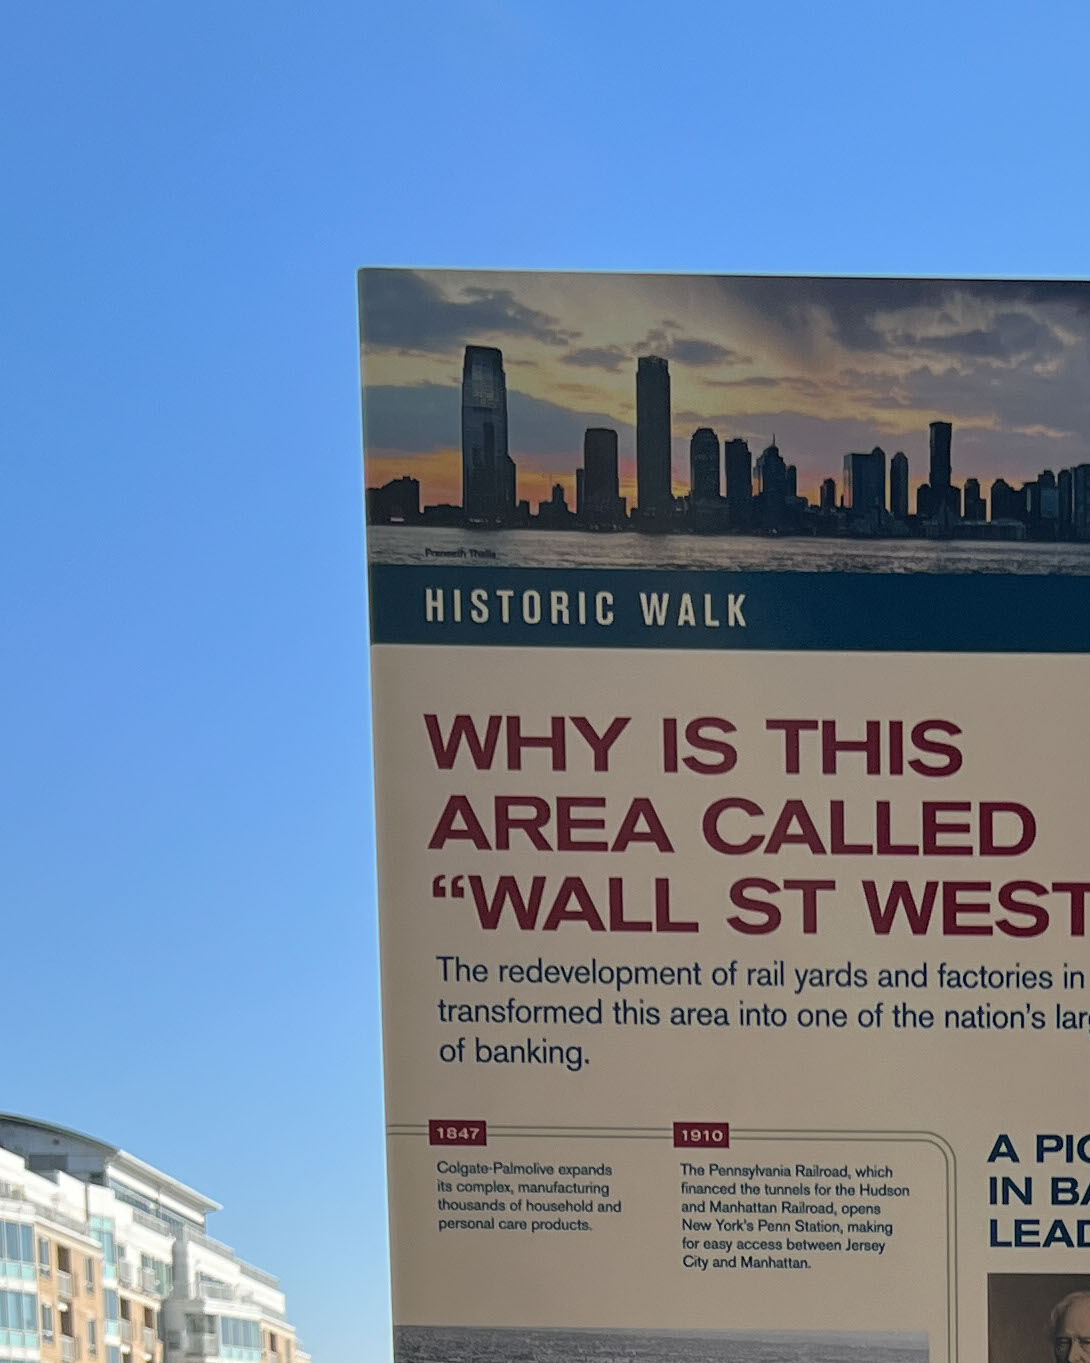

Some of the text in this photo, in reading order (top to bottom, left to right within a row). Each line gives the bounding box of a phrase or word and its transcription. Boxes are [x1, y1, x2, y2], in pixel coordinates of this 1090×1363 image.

[426, 588, 746, 626] HISTORIC WALK
[424, 714, 962, 777] WHY IS THIS
[428, 795, 1036, 856] AREA CALLED
[727, 878, 836, 934] ST
[436, 956, 488, 982] The
[500, 958, 702, 992] redevelopment
[712, 960, 737, 986] of
[748, 960, 784, 986] rail
[795, 962, 867, 994] yards
[878, 962, 927, 988] and
[938, 963, 1052, 989] factories
[1064, 963, 1084, 989] in
[438, 998, 602, 1024] transformed
[613, 999, 660, 1025] this
[670, 1008, 730, 1026] area
[740, 1001, 786, 1026] into
[798, 1009, 847, 1027] one
[858, 1002, 883, 1027] of
[892, 1002, 934, 1028] the
[946, 1003, 1045, 1029] nation’s
[440, 1037, 589, 1071] of banking.
[437, 1127, 479, 1139] 1847
[682, 1130, 722, 1141] 1910
[988, 1134, 1020, 1162] A
[437, 1161, 612, 1178] Colgate-Palmolive expands
[680, 1163, 892, 1180] The Pennsylvania Railroad, which
[437, 1179, 609, 1197] its complex, manufacturing
[681, 1182, 909, 1196] financed the tunnels for the Hudson
[990, 1176, 1032, 1205] IN
[438, 1198, 621, 1212] thousands of household and
[439, 1217, 592, 1233] personal care products.
